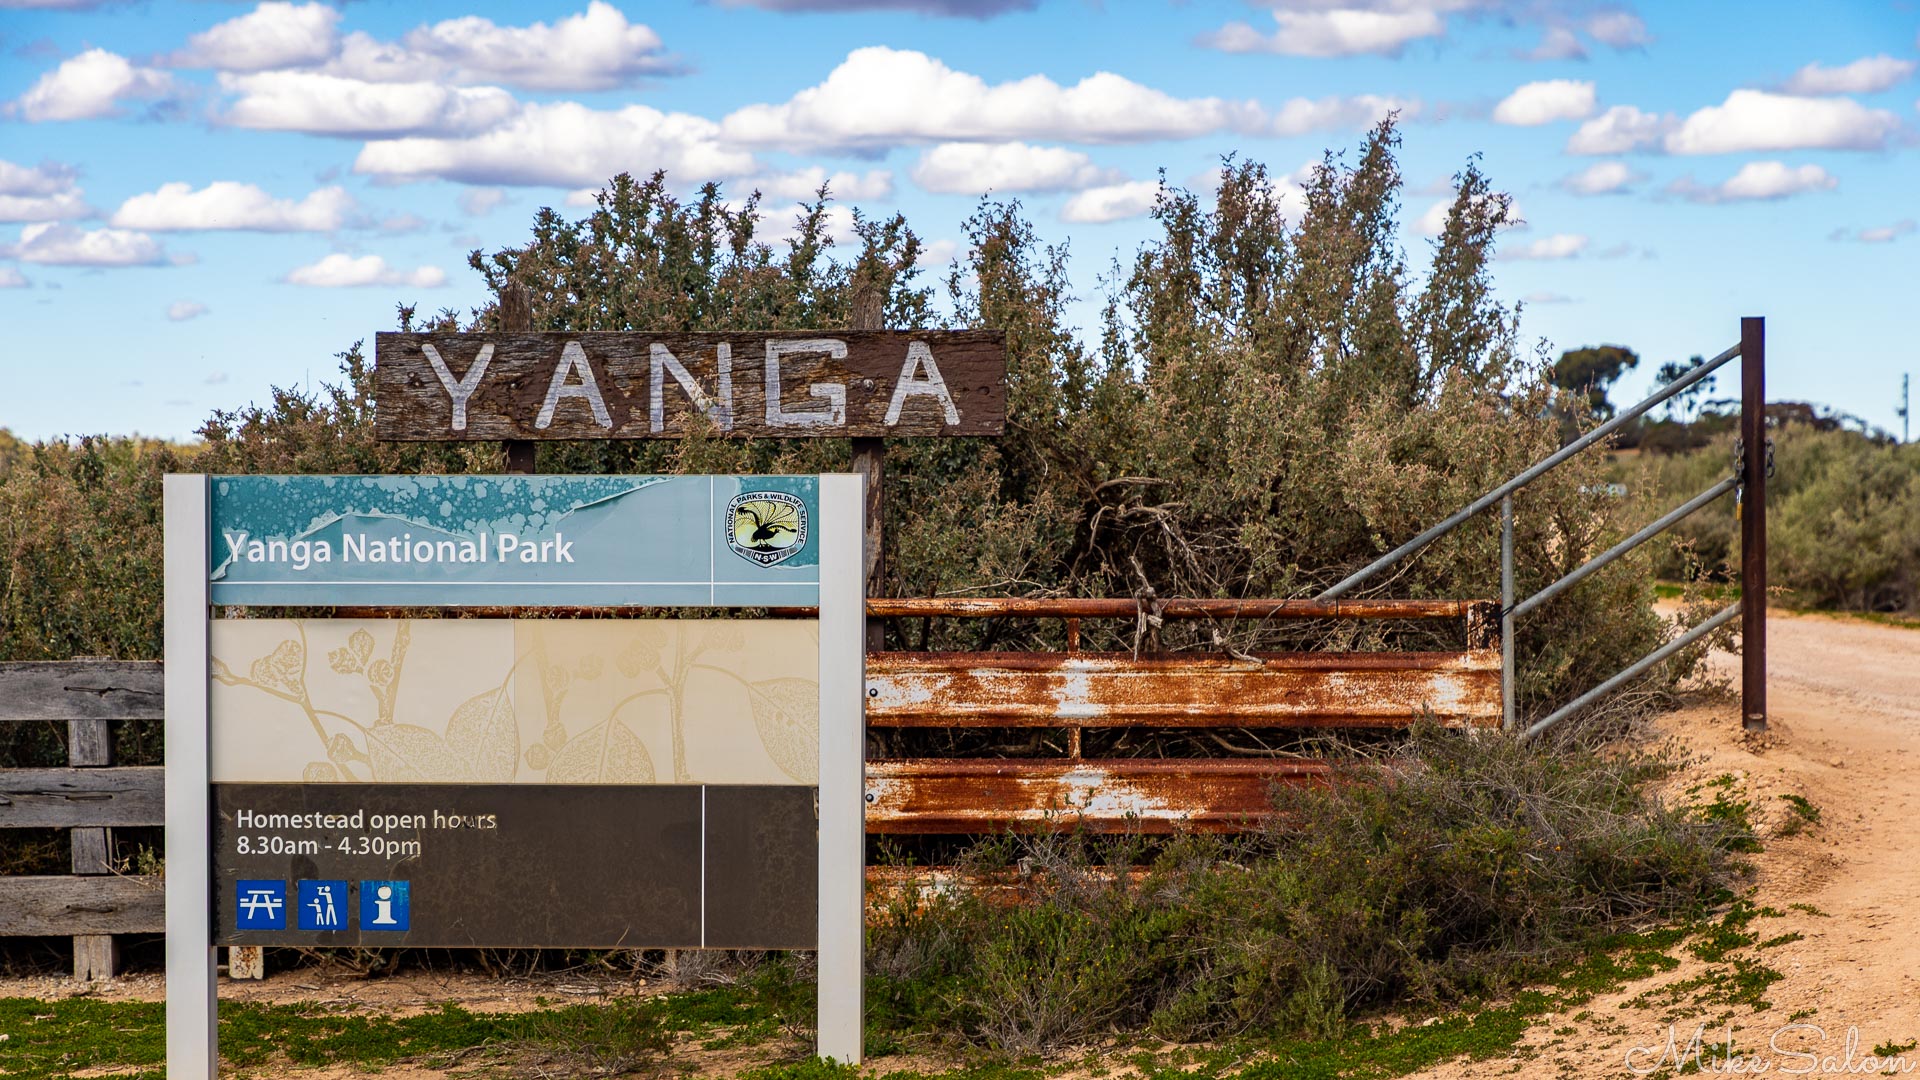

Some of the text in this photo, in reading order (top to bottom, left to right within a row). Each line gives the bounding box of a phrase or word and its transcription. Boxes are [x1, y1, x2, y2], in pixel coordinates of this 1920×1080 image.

[421, 340, 961, 432] YANGA
[727, 503, 737, 544] NATIONAL
[737, 494, 763, 503] PARKS
[770, 494, 802, 508] WILDLIFE
[798, 510, 807, 544] SERVICE
[224, 533, 575, 570] Yanga National Park
[237, 809, 363, 829] Homestead
[370, 814, 426, 833] open
[236, 836, 318, 855] 8.30am
[338, 836, 421, 859] 4.30pm
